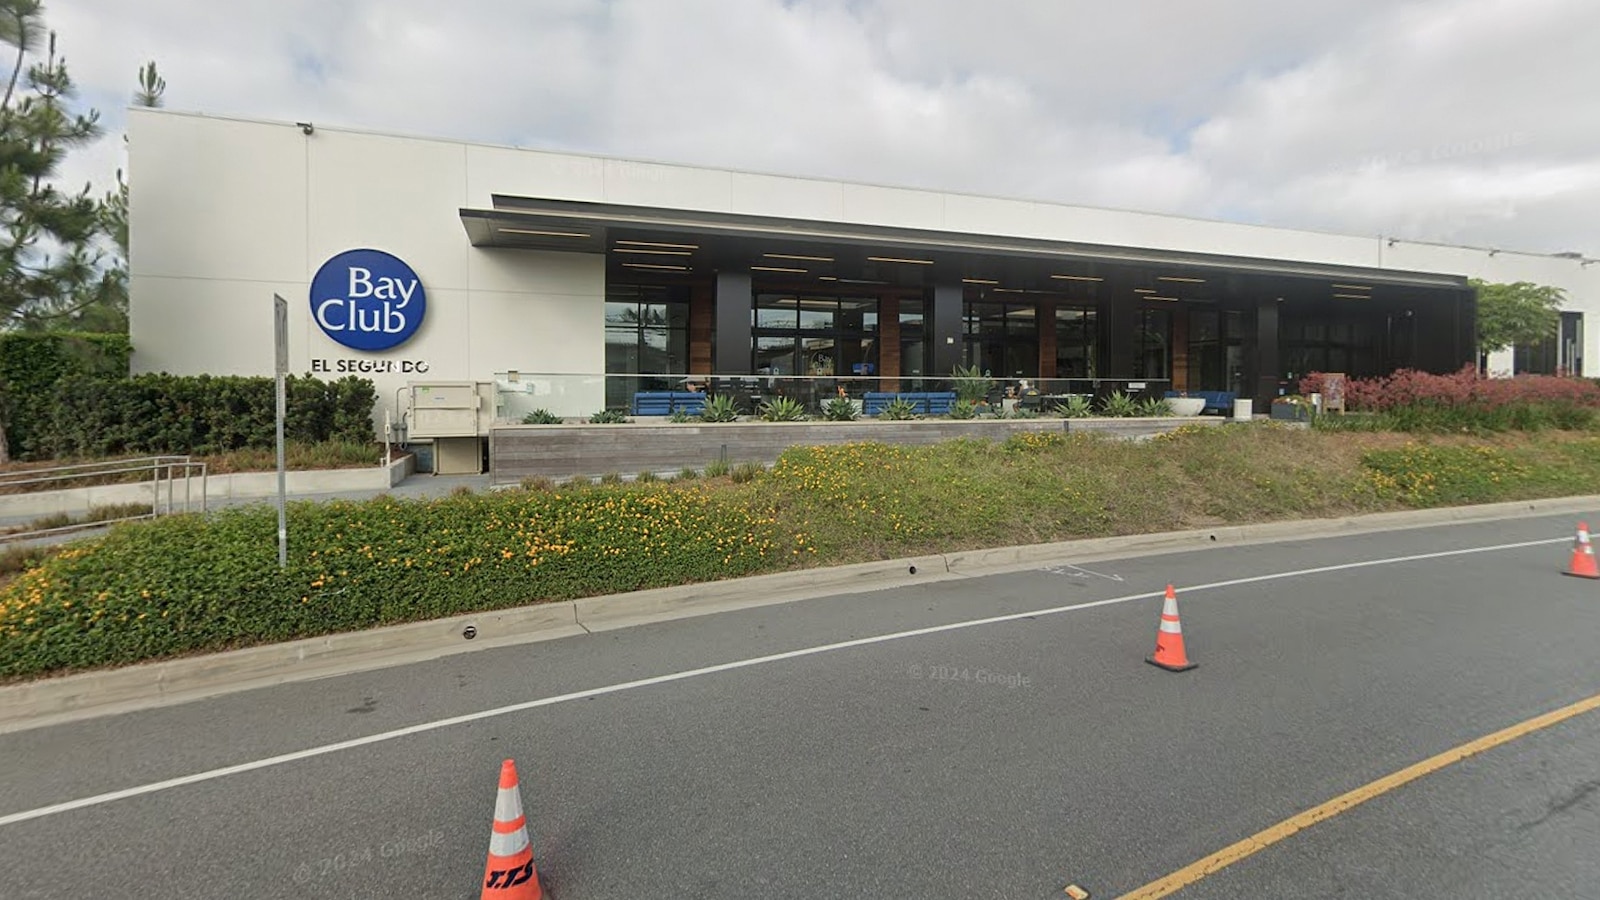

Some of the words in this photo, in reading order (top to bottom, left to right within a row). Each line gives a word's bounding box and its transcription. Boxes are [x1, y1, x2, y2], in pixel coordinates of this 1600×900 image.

[348, 267, 418, 309] Bay
[317, 299, 406, 333] Club
[311, 359, 331, 372] EL
